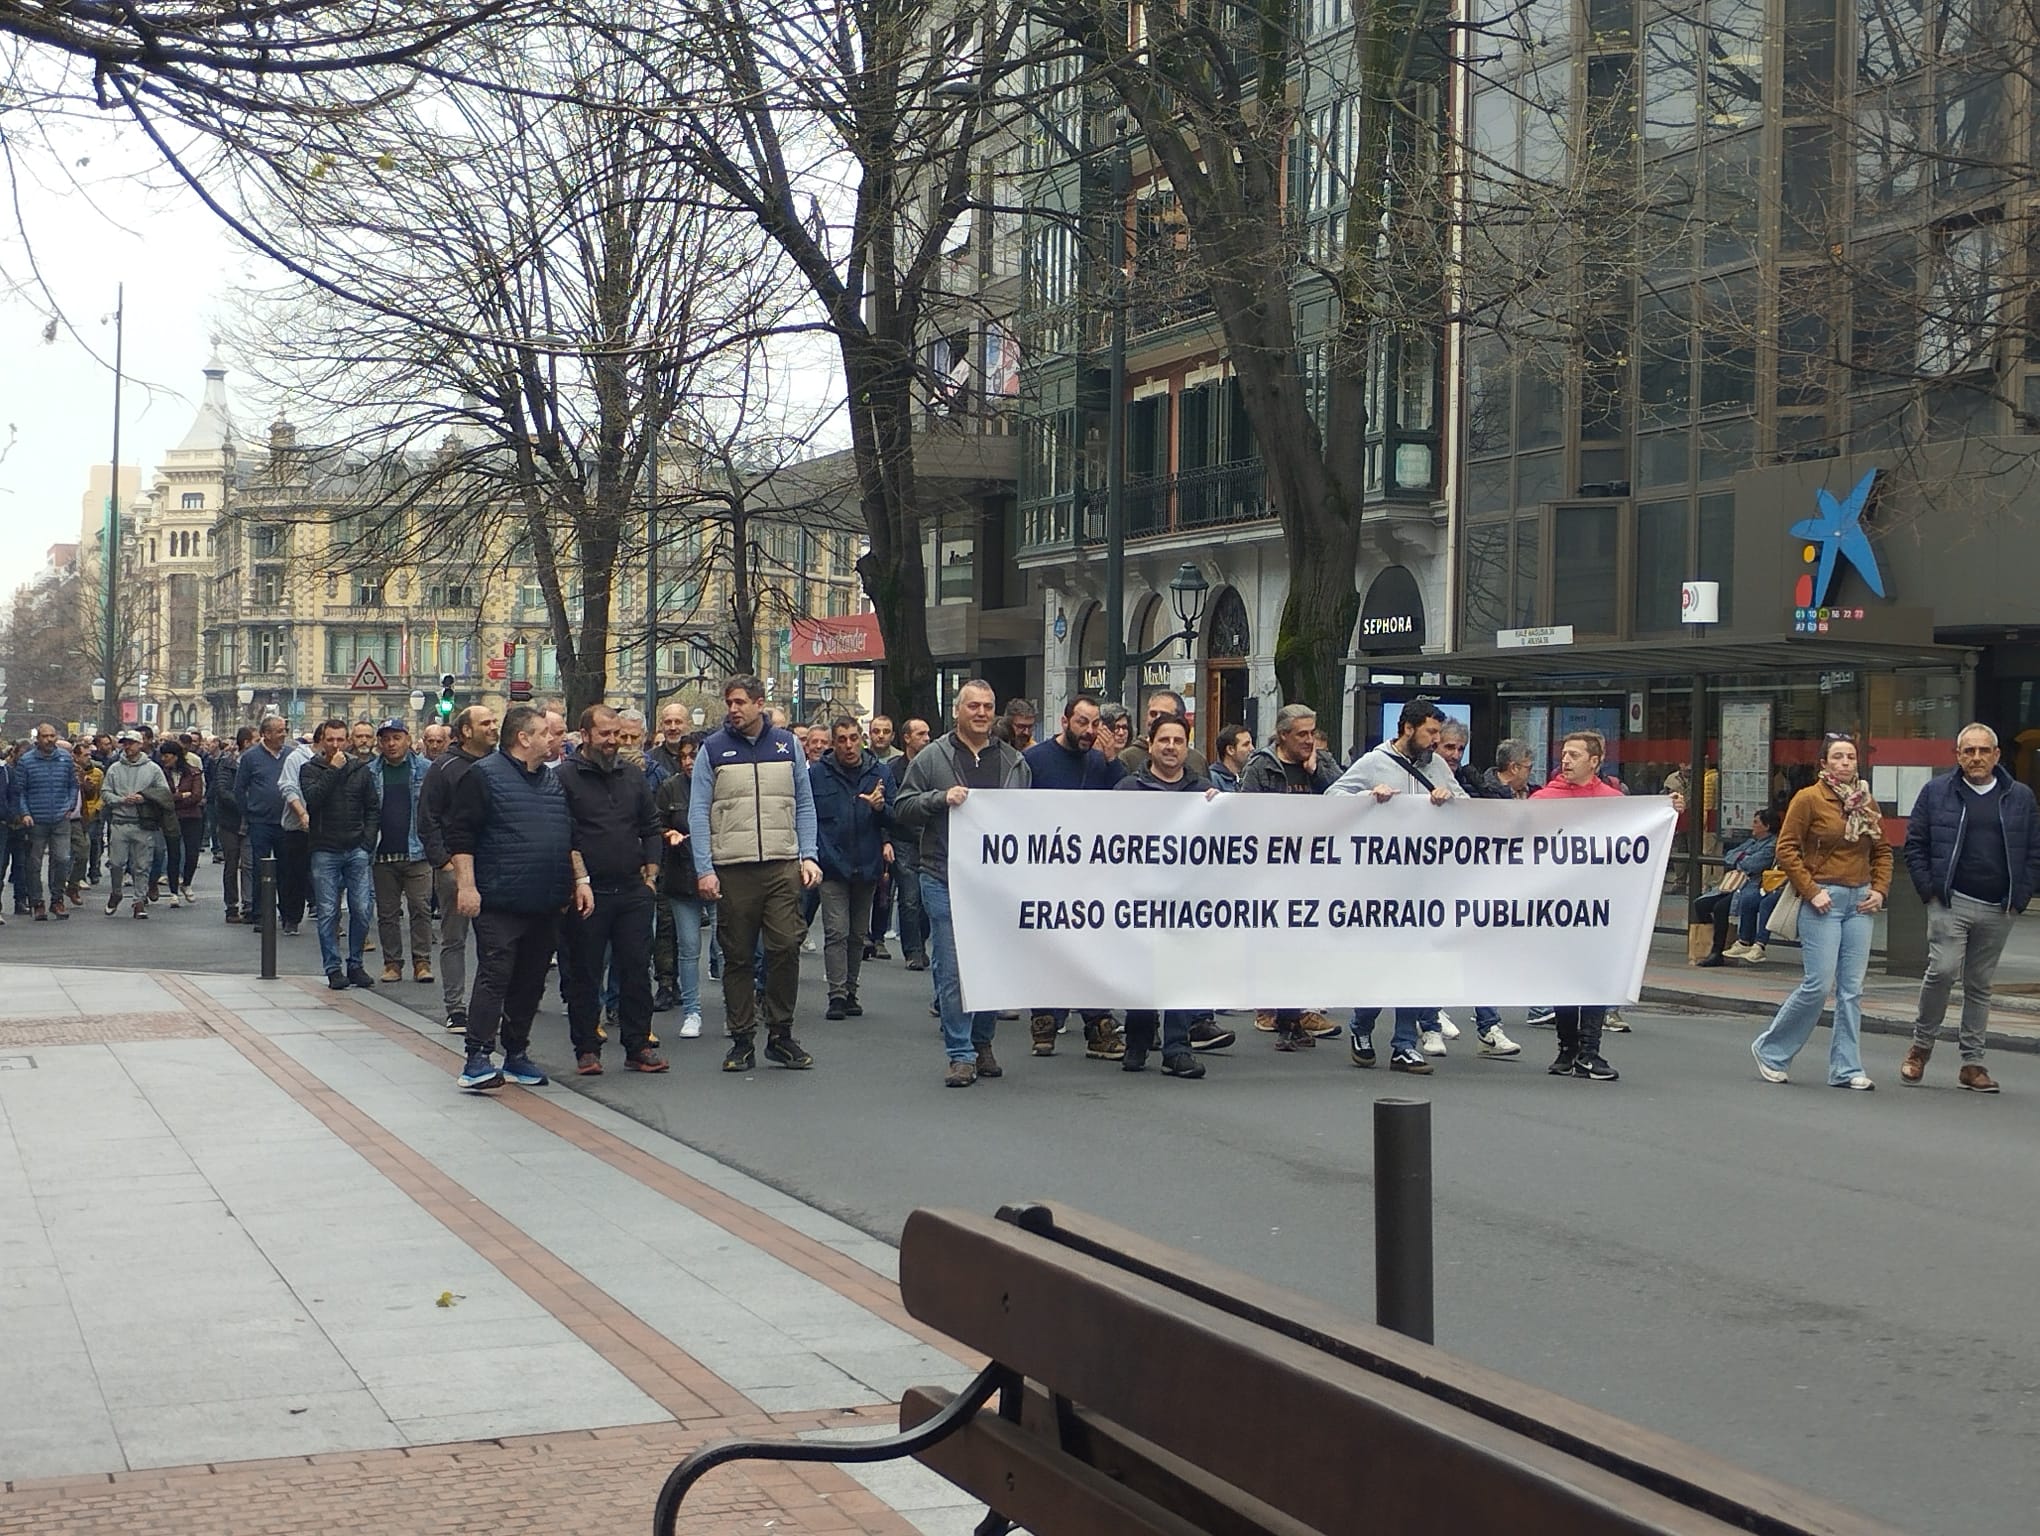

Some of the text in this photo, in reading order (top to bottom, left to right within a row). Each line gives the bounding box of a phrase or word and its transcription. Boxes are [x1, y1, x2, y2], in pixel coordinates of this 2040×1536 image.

[1363, 616, 1412, 635] SEPHORA
[983, 827, 1649, 865] NO MÁS AGRESIONES EN EL TRANSPORTE PÚBLICO
[1019, 899, 1609, 929] ERASO GEHIAGORIK EZ GARRAIO PUBLIKOAN
